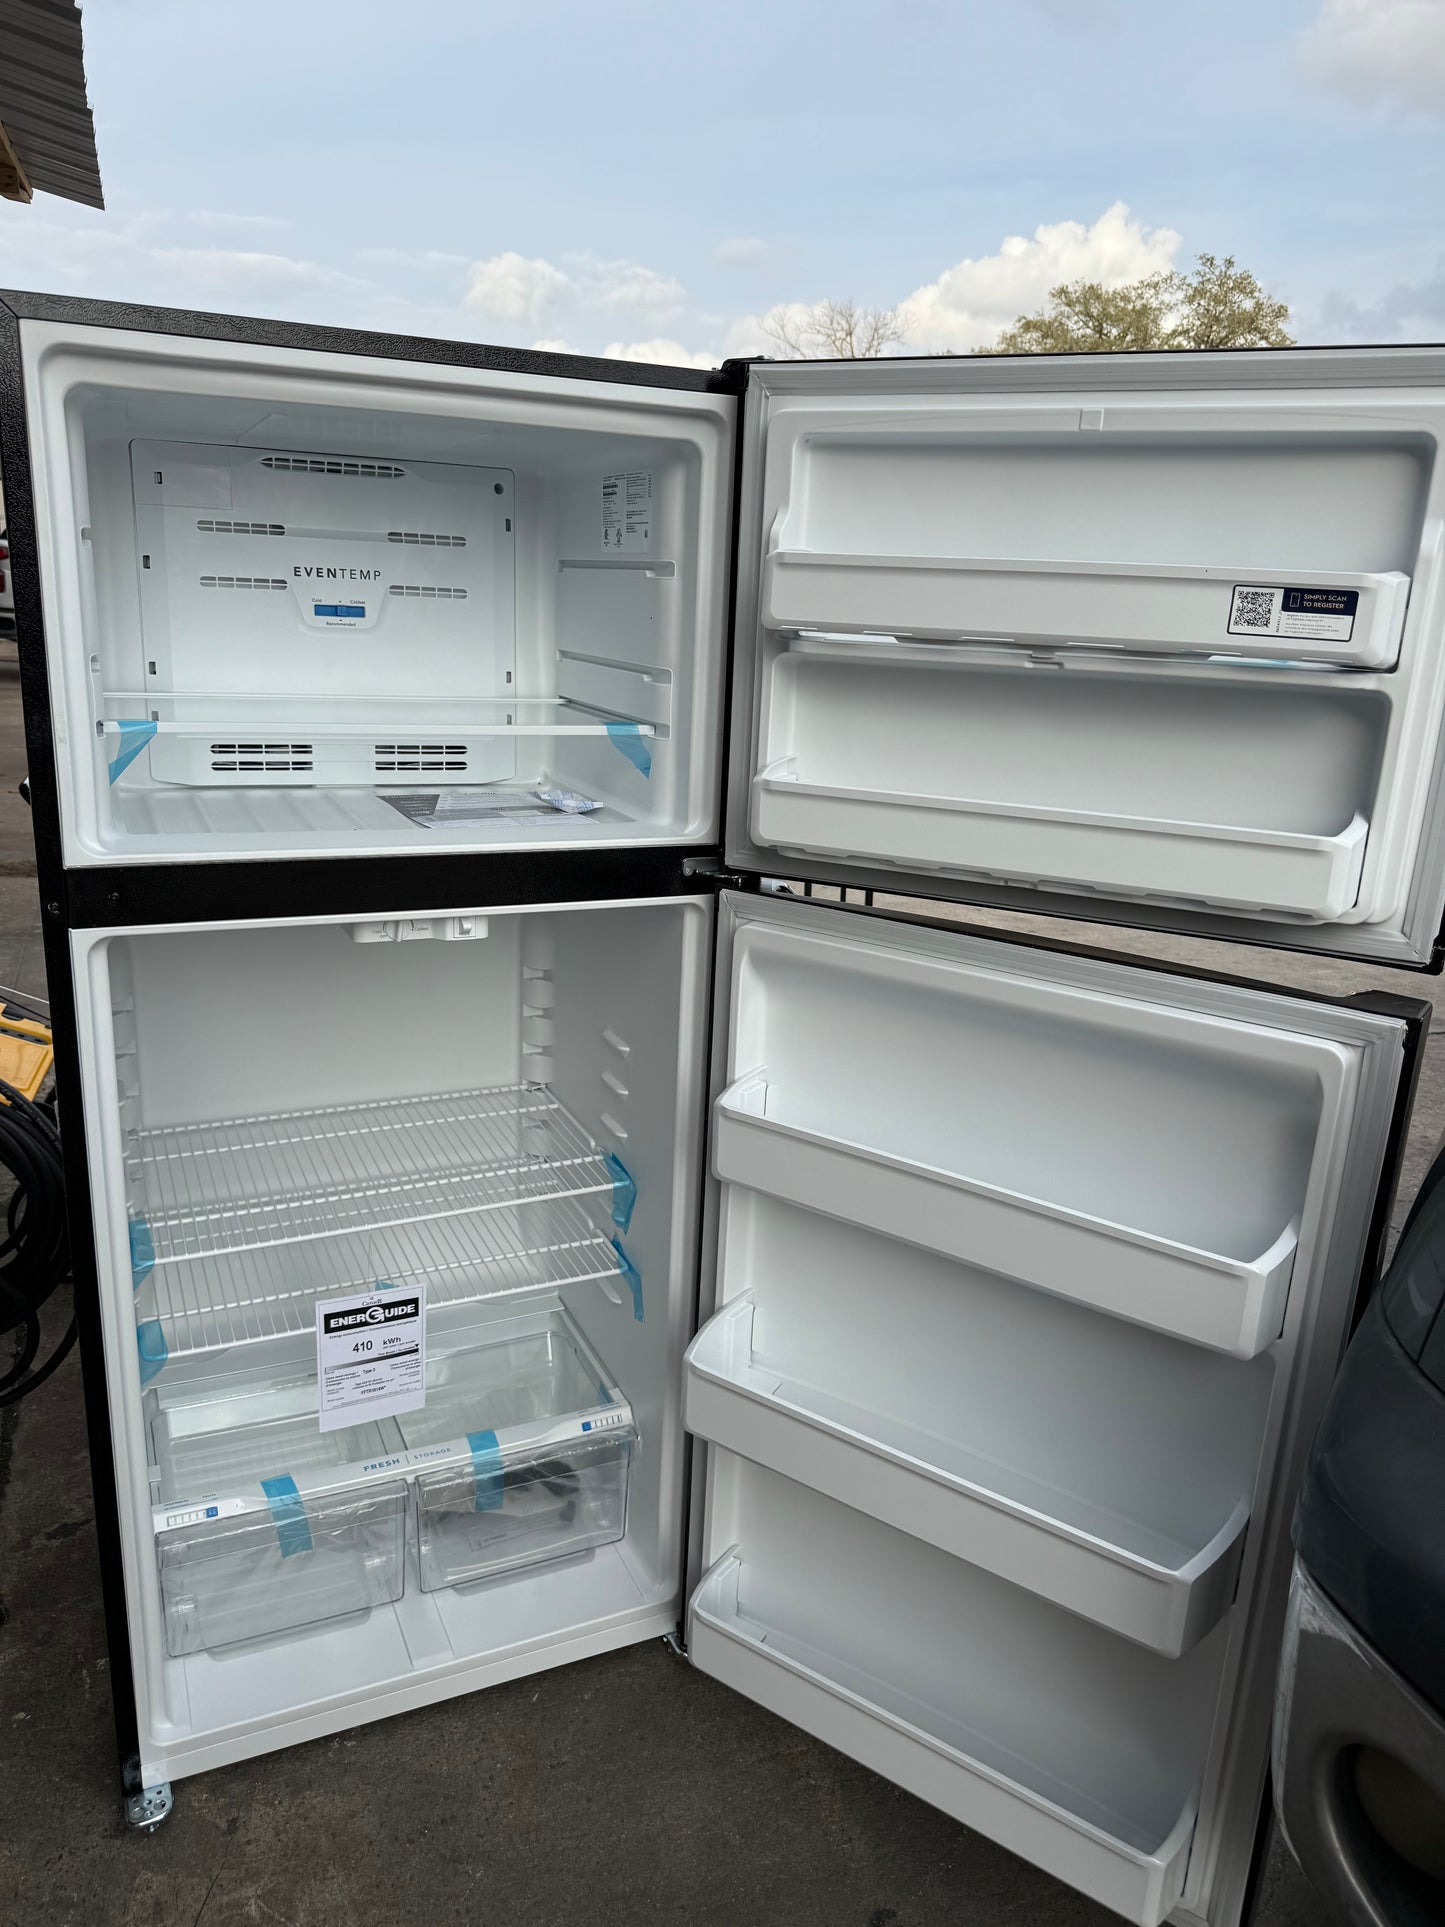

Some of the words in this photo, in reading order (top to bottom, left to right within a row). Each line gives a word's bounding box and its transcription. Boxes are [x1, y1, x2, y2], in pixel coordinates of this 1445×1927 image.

[294, 566, 381, 580] EVENTEMP
[330, 1304, 416, 1328] ENERGUIDE
[352, 1340, 373, 1352] 410
[383, 1336, 401, 1346] kWh
[364, 1458, 400, 1472] FRESH
[414, 1448, 452, 1459] STORAGE
